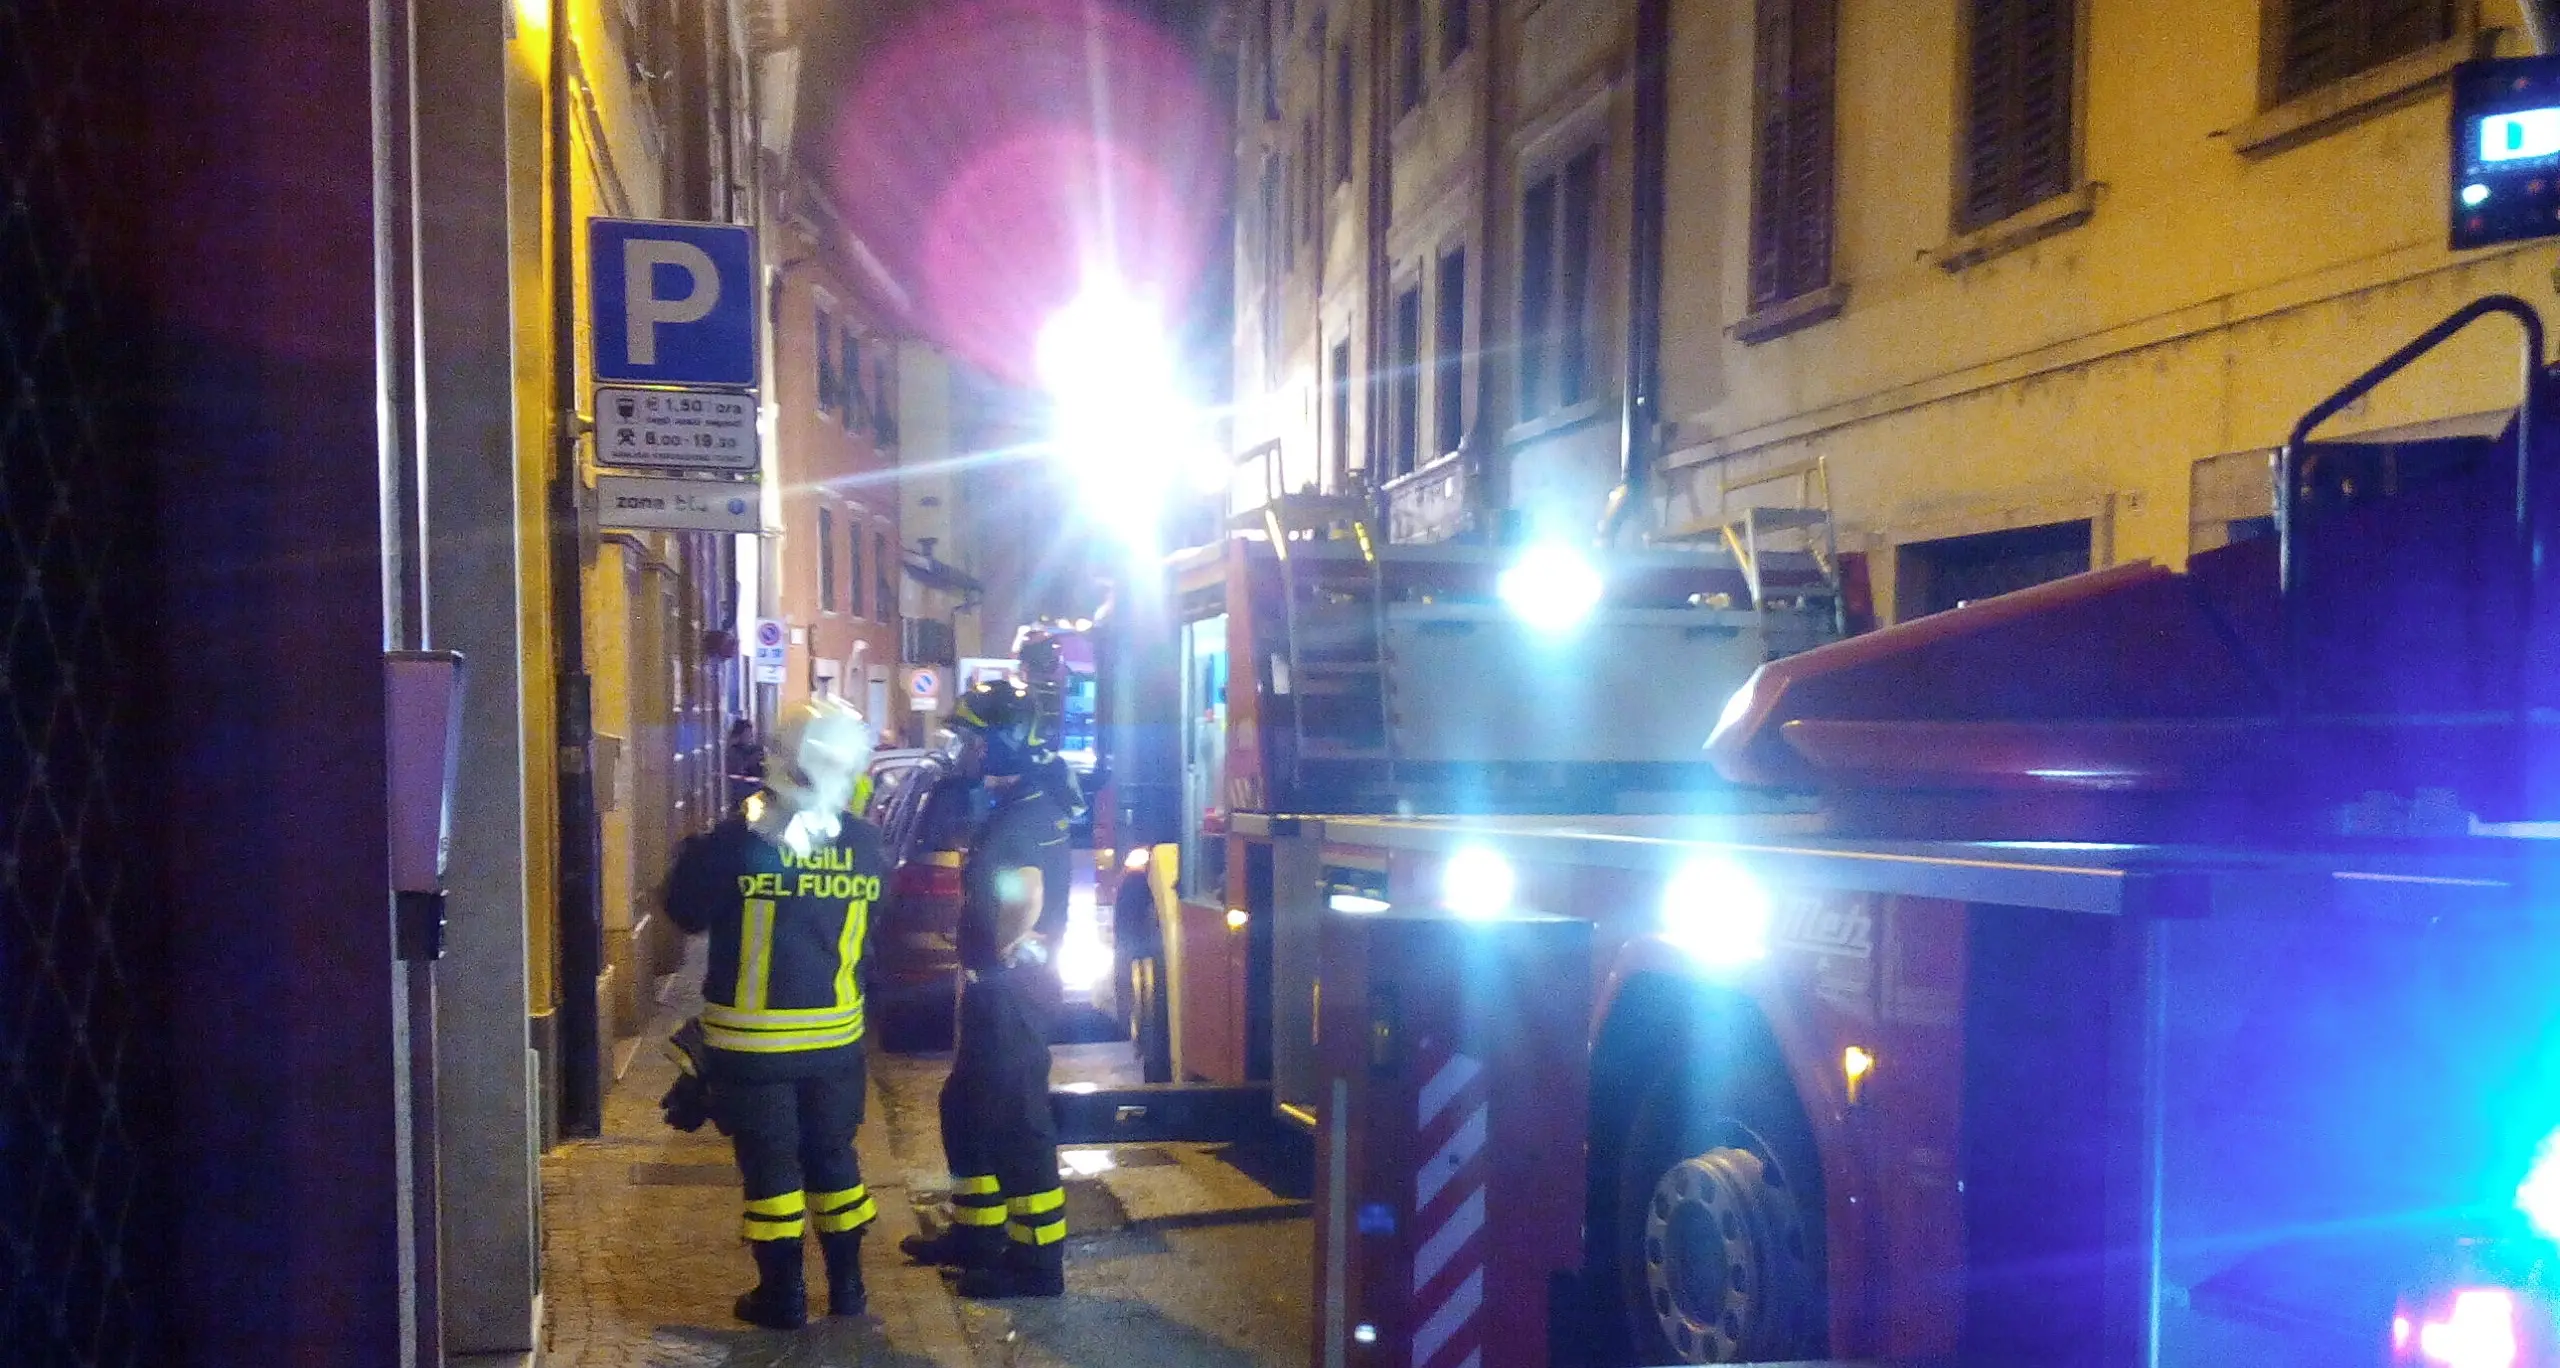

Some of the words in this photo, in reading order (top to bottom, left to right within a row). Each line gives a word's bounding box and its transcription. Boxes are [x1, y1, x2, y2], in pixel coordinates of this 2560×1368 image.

[623, 238, 721, 365] P
[715, 403, 742, 415] ora
[616, 496, 665, 510] zona
[778, 846, 854, 871] VIGILI
[738, 873, 792, 897] DEL
[797, 874, 881, 901] FUOCO
